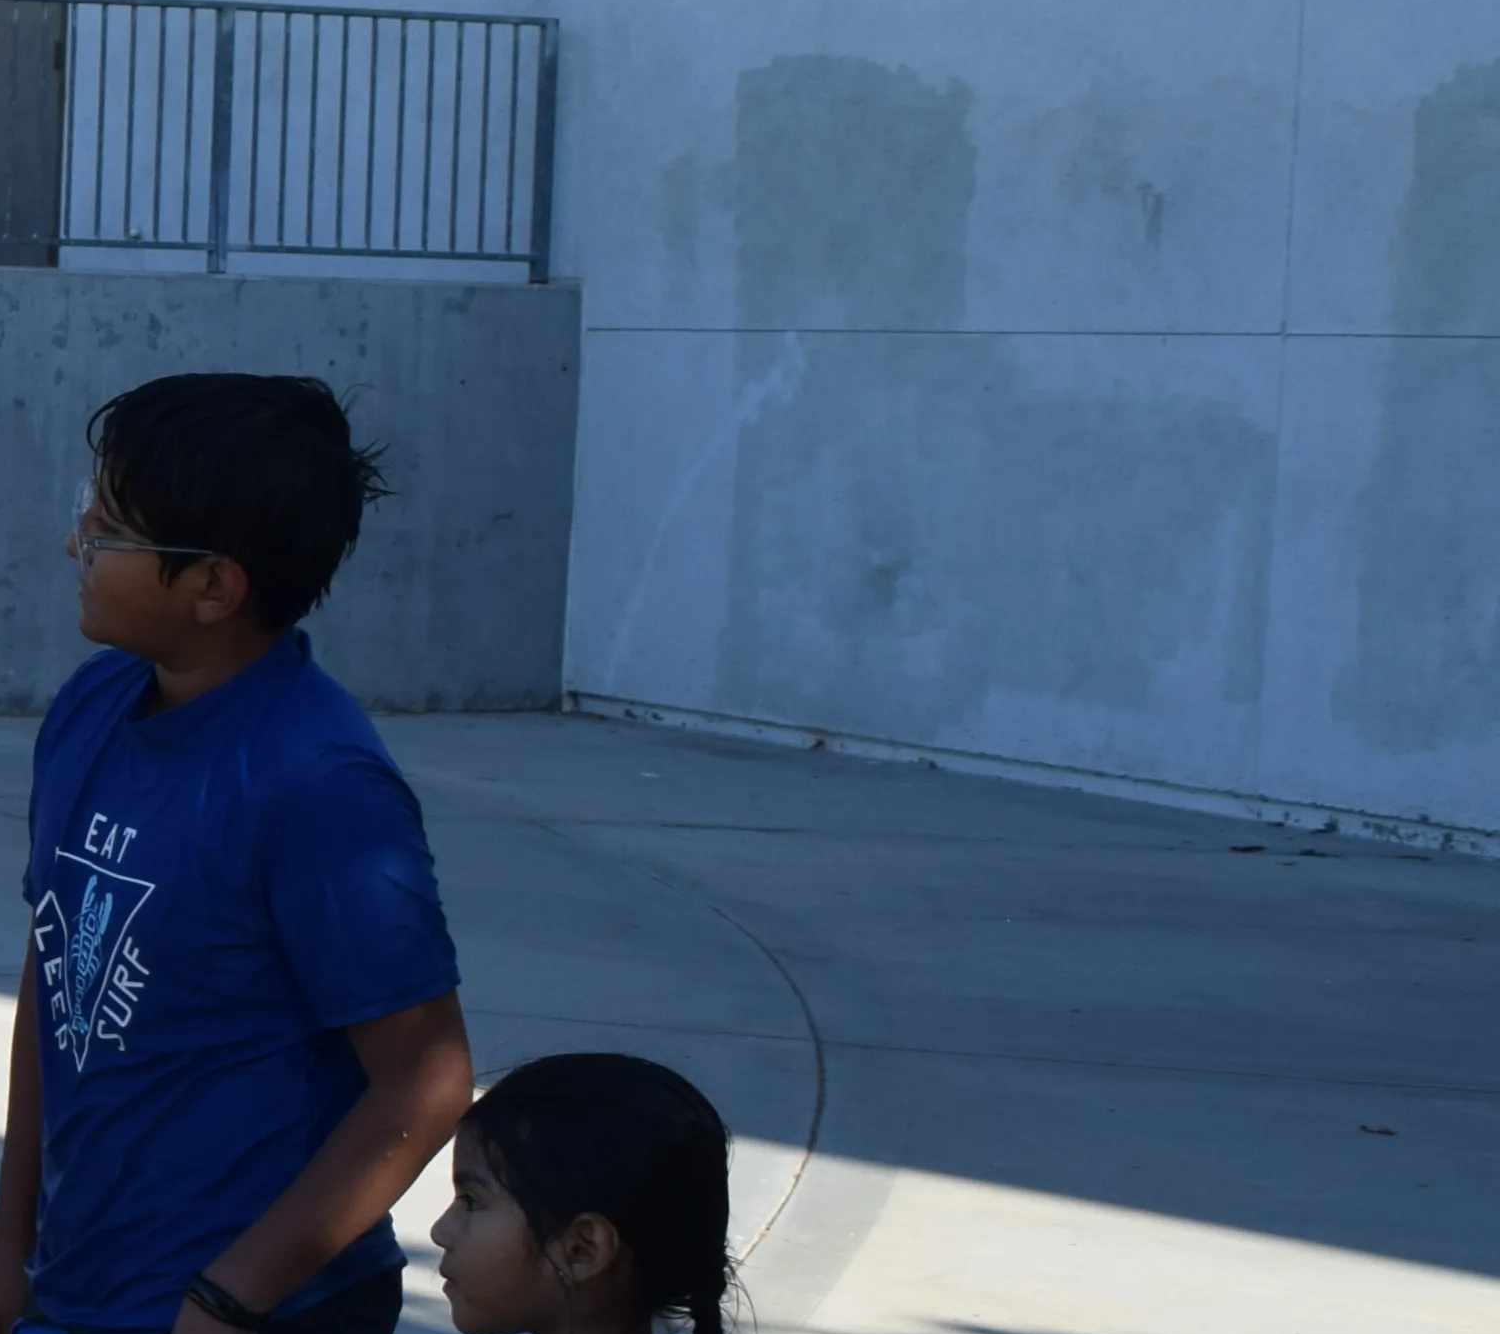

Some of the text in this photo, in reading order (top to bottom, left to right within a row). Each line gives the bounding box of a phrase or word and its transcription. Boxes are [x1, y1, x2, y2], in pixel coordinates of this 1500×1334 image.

[84, 812, 138, 863] EAT
[34, 924, 69, 1050] LEEP
[97, 936, 151, 1052] SURF
